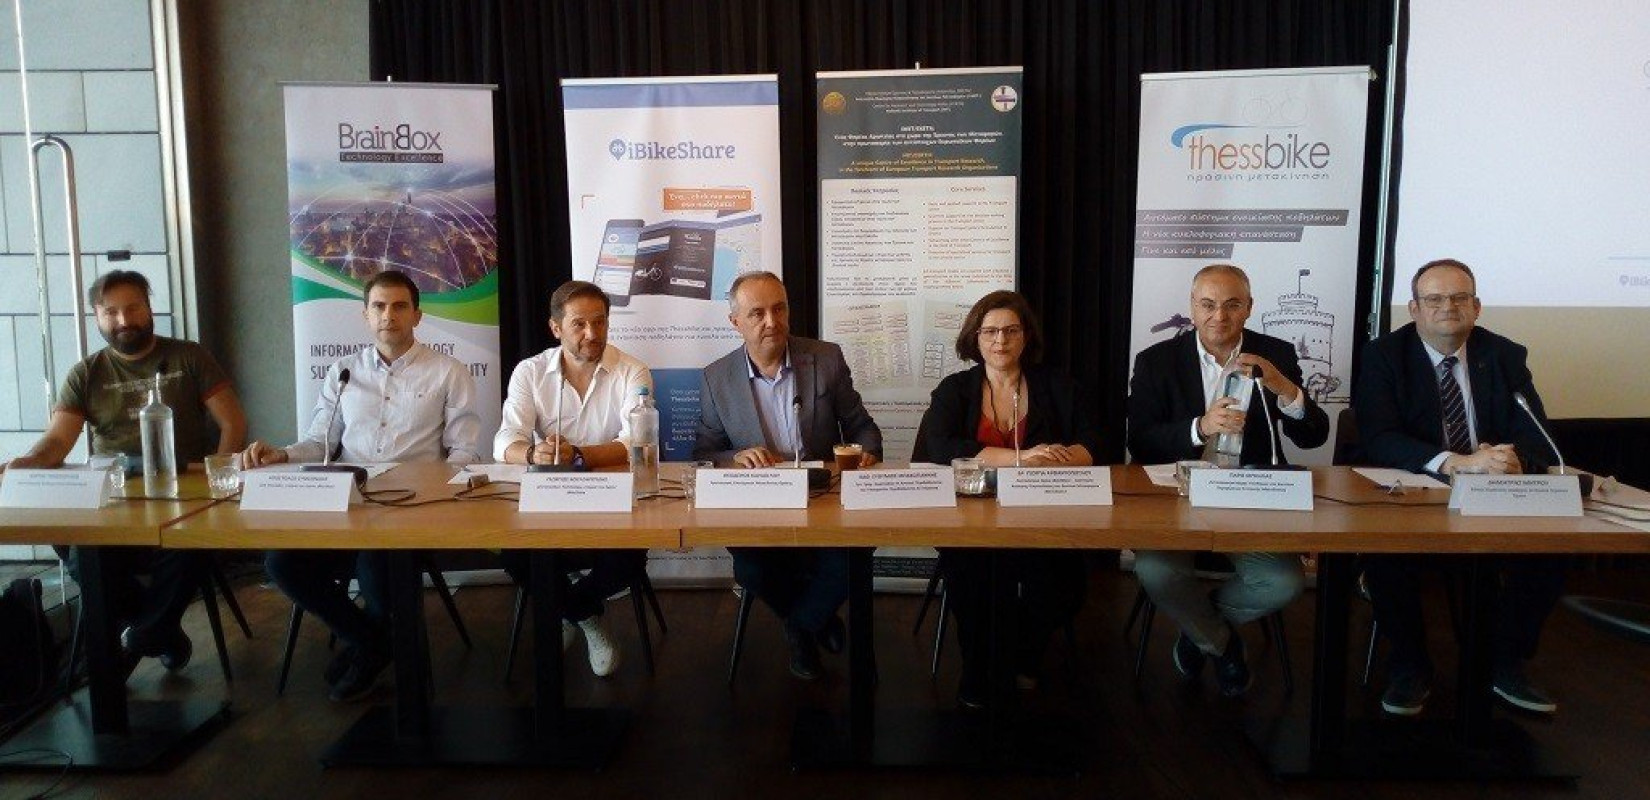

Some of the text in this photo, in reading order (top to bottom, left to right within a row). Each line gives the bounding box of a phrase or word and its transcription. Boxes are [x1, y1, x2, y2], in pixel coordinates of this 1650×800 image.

[338, 122, 442, 151] BrainBox
[629, 141, 736, 160] iBikeShare
[1189, 133, 1330, 170] thessbike
